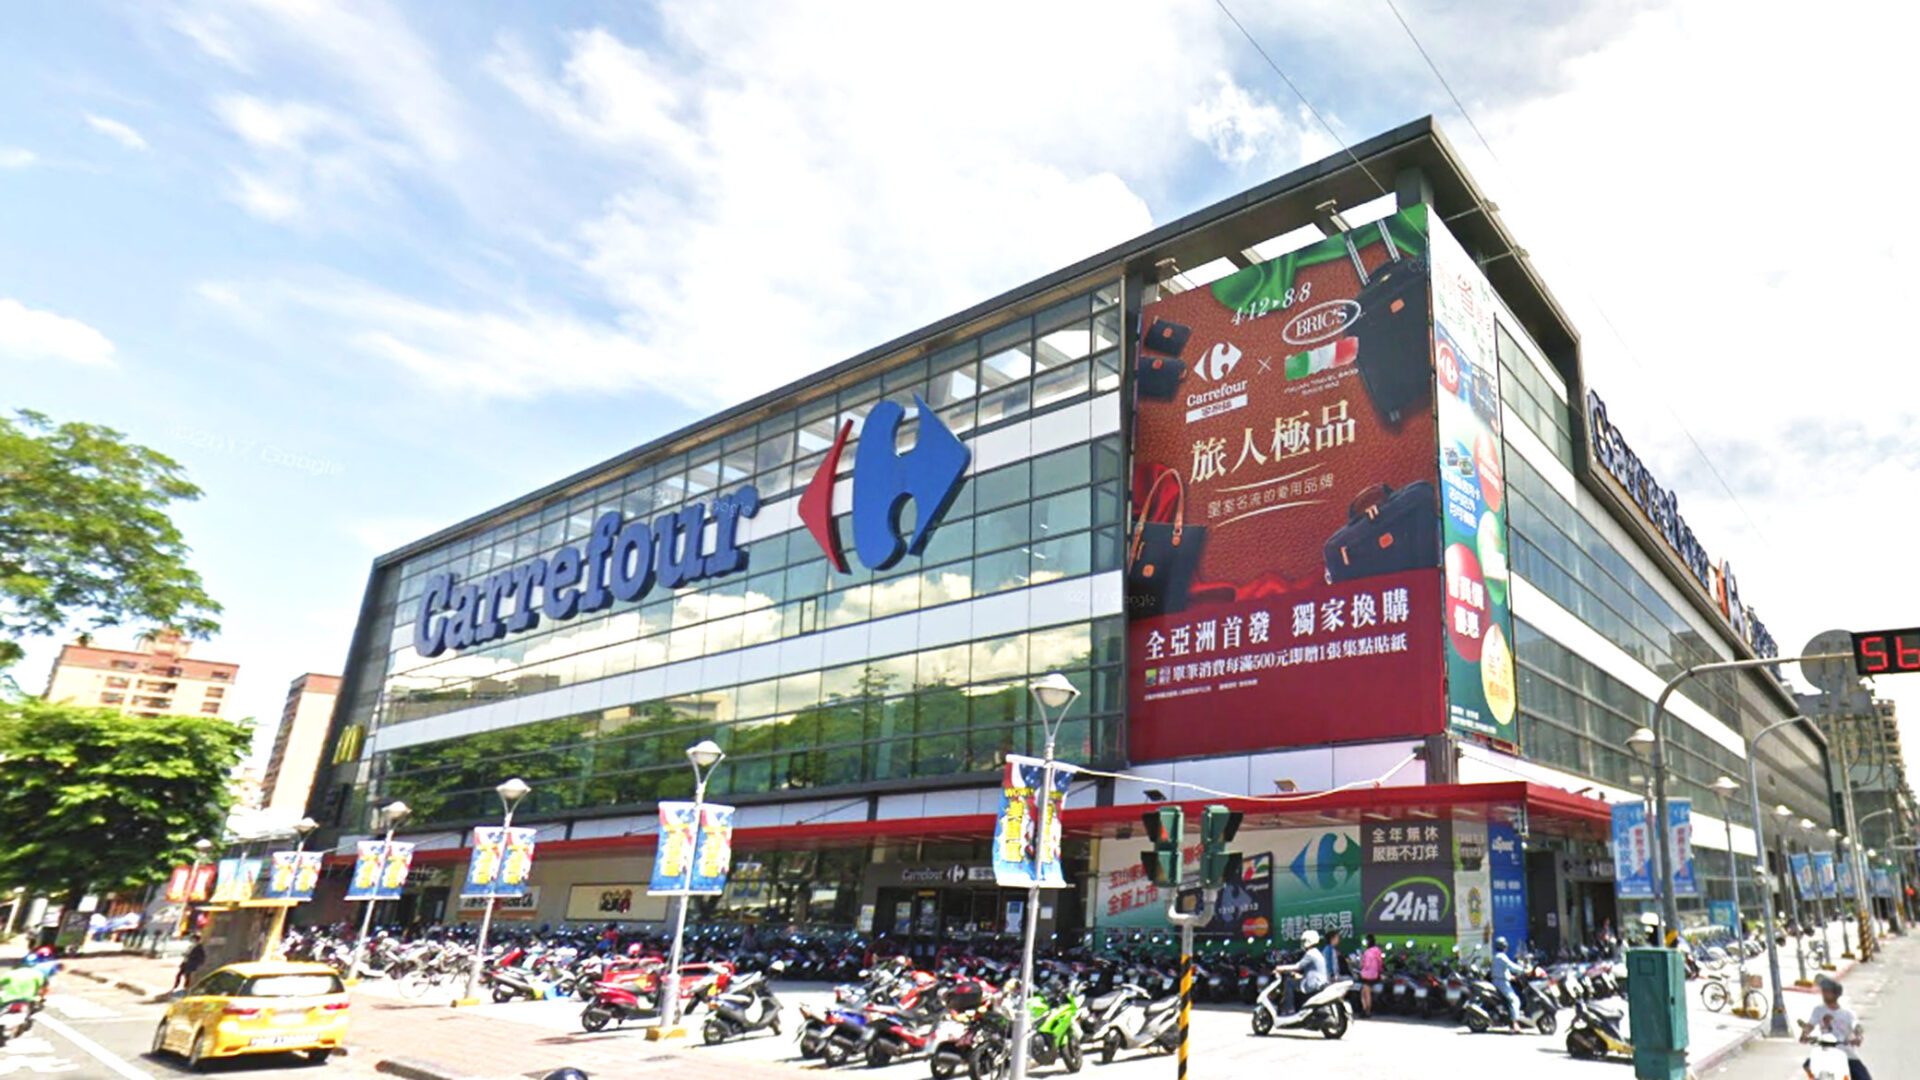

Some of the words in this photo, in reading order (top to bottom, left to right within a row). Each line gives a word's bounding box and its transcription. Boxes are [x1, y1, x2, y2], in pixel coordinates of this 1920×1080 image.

[1295, 304, 1348, 338] BRIC'S
[1186, 379, 1248, 407] Carrefour
[1189, 399, 1356, 485] 旅人極品
[414, 484, 760, 658] Carrefour
[1145, 610, 1271, 661] 全亞洲首發
[1291, 588, 1410, 637] 獨家換購
[1372, 826, 1439, 844] 全年無休
[1372, 844, 1439, 862] 服務不打烊
[1107, 884, 1159, 916] 全新上市
[1379, 891, 1428, 922] 24h
